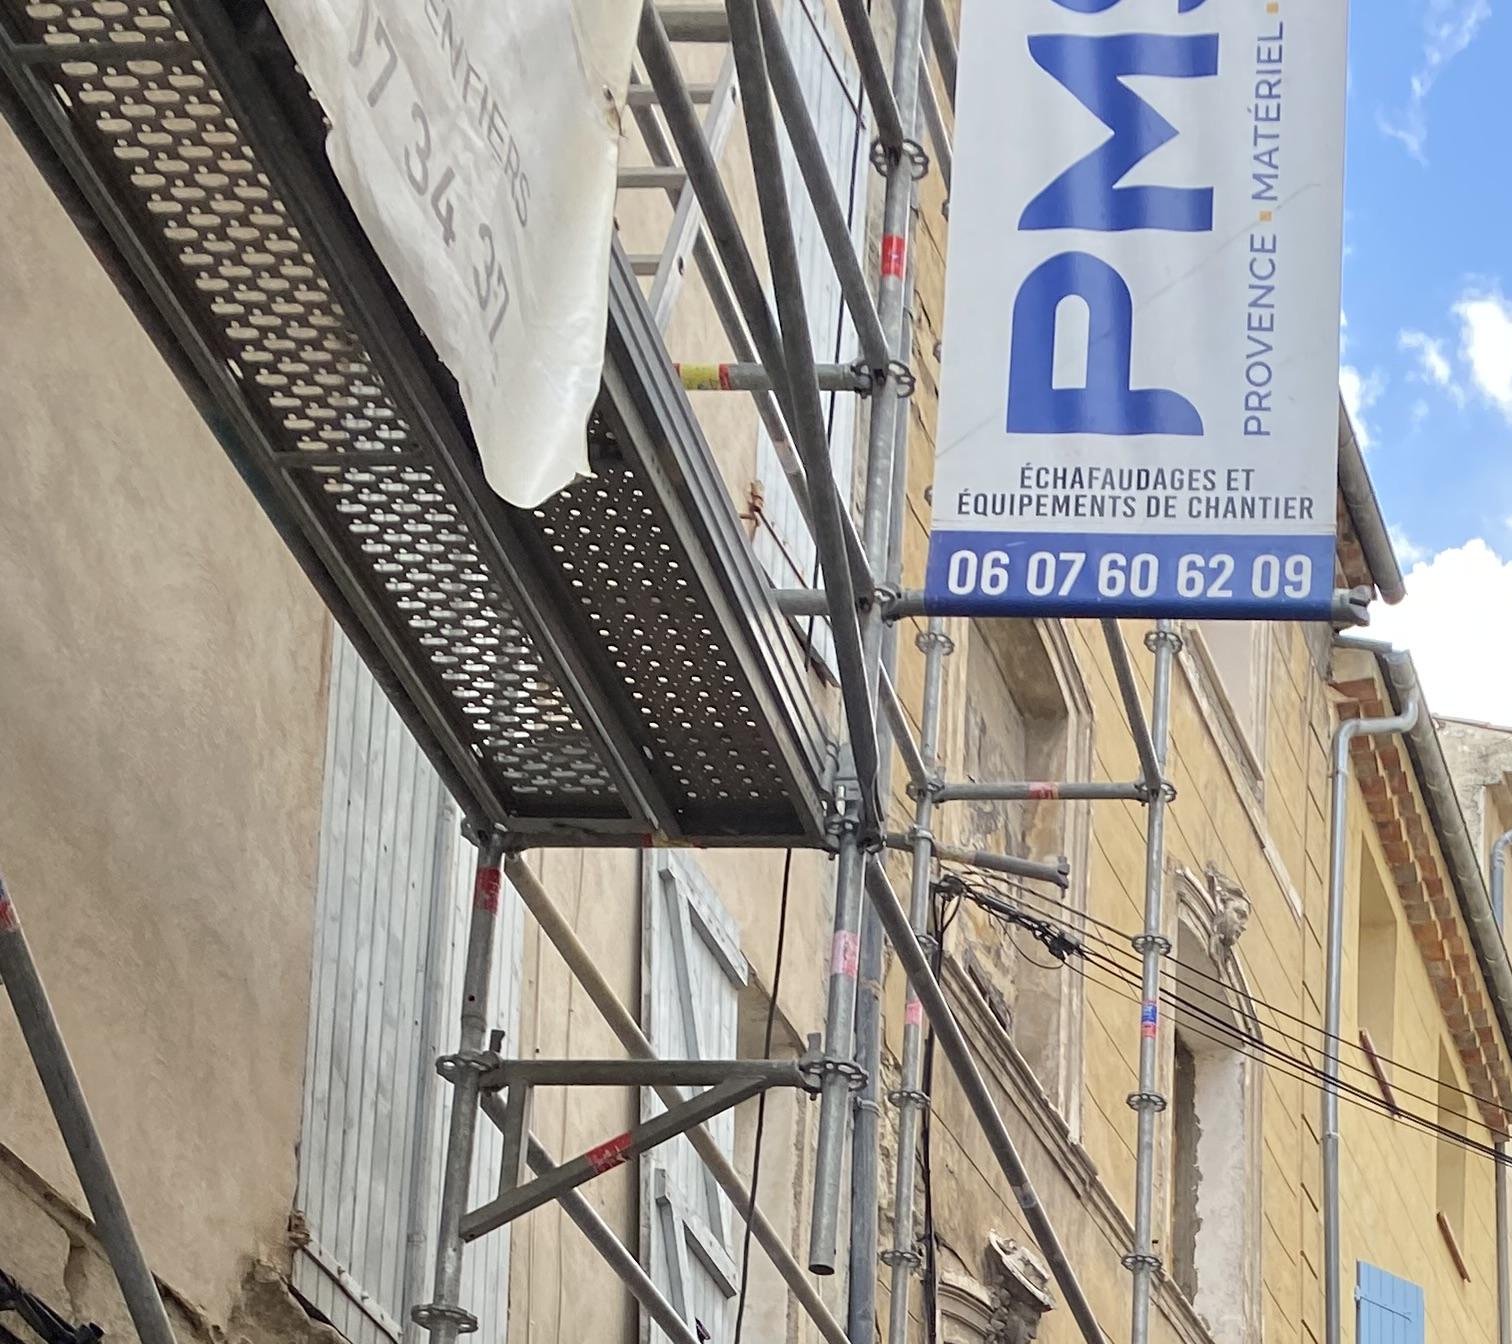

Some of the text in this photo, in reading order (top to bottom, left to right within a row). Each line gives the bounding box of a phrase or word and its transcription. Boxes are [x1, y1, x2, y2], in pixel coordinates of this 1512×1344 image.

[404, 102, 455, 247] 34
[473, 222, 510, 345] 37
[1007, 0, 1219, 436] PM
[1244, 21, 1284, 437] PROVENCE MATÉRIEL
[957, 488, 1314, 520] ÉQUIPEMENTS DE CHANTIER
[1020, 462, 1256, 492] ÉCHAFAUDAGES ET
[948, 550, 1312, 599] 06 07 60 62 09
